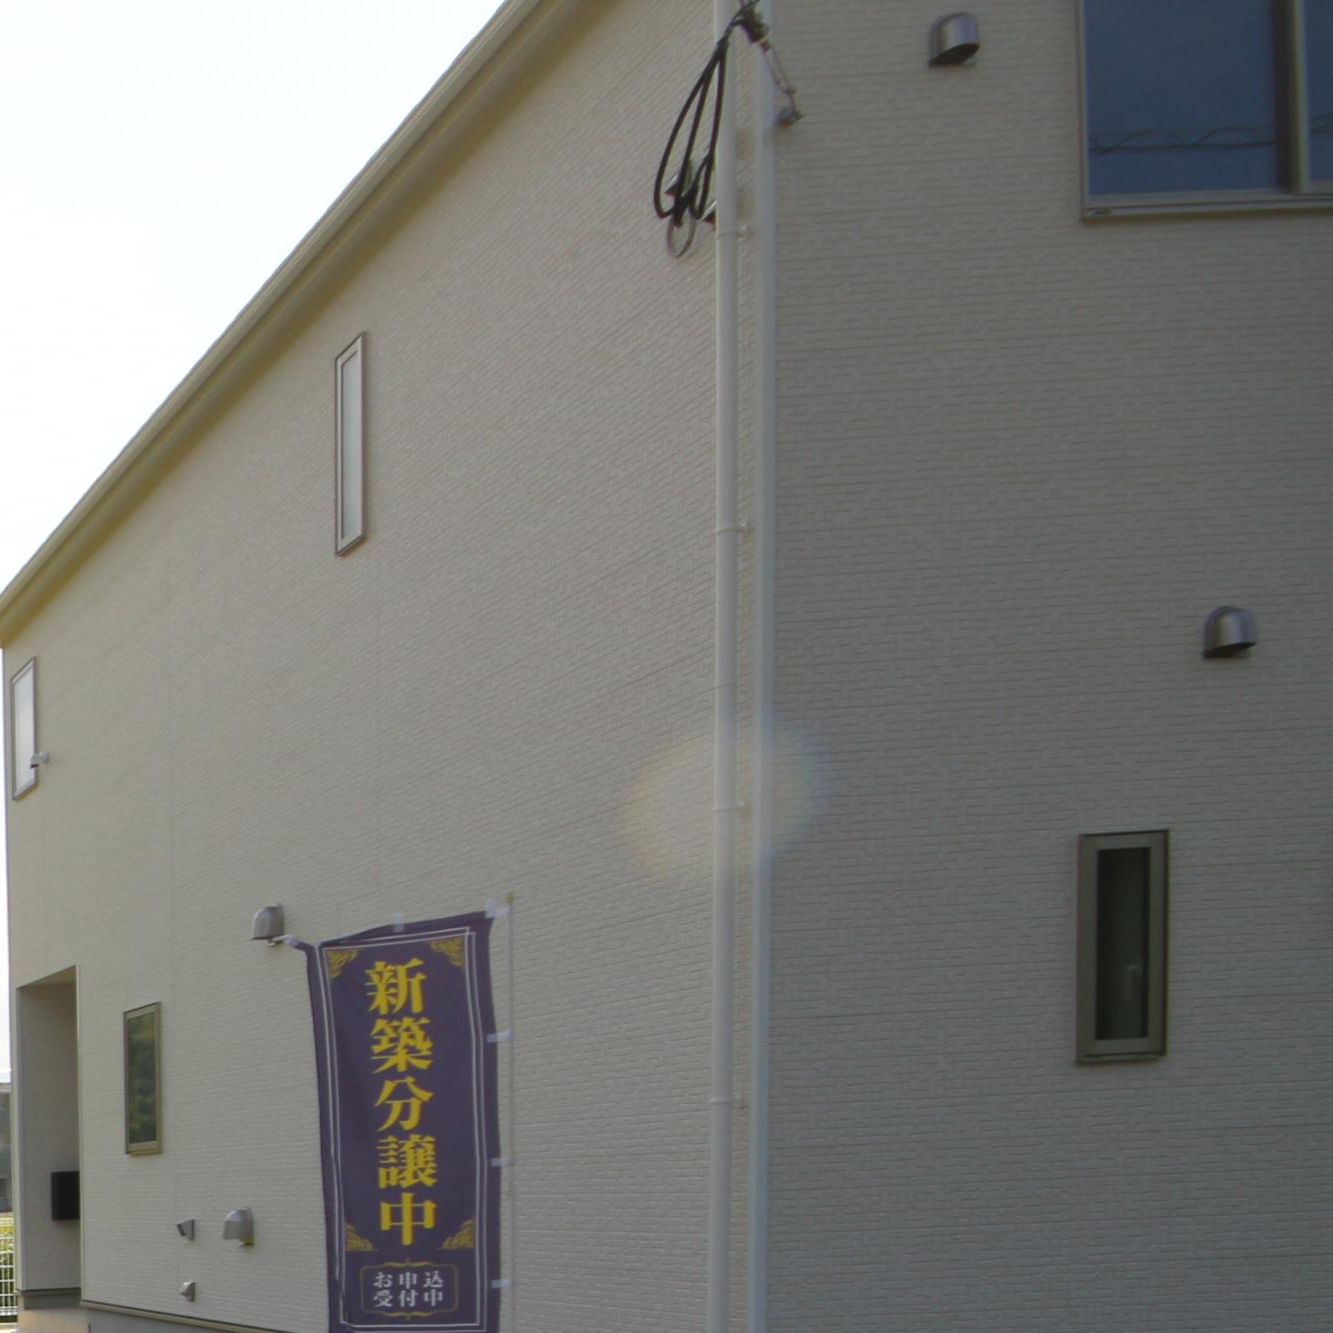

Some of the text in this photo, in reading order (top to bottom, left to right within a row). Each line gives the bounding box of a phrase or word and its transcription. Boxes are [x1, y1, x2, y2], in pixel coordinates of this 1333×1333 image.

[365, 957, 438, 1247] 新築分譲中
[373, 1270, 444, 1289] お申込
[373, 1289, 444, 1308] 受付中
